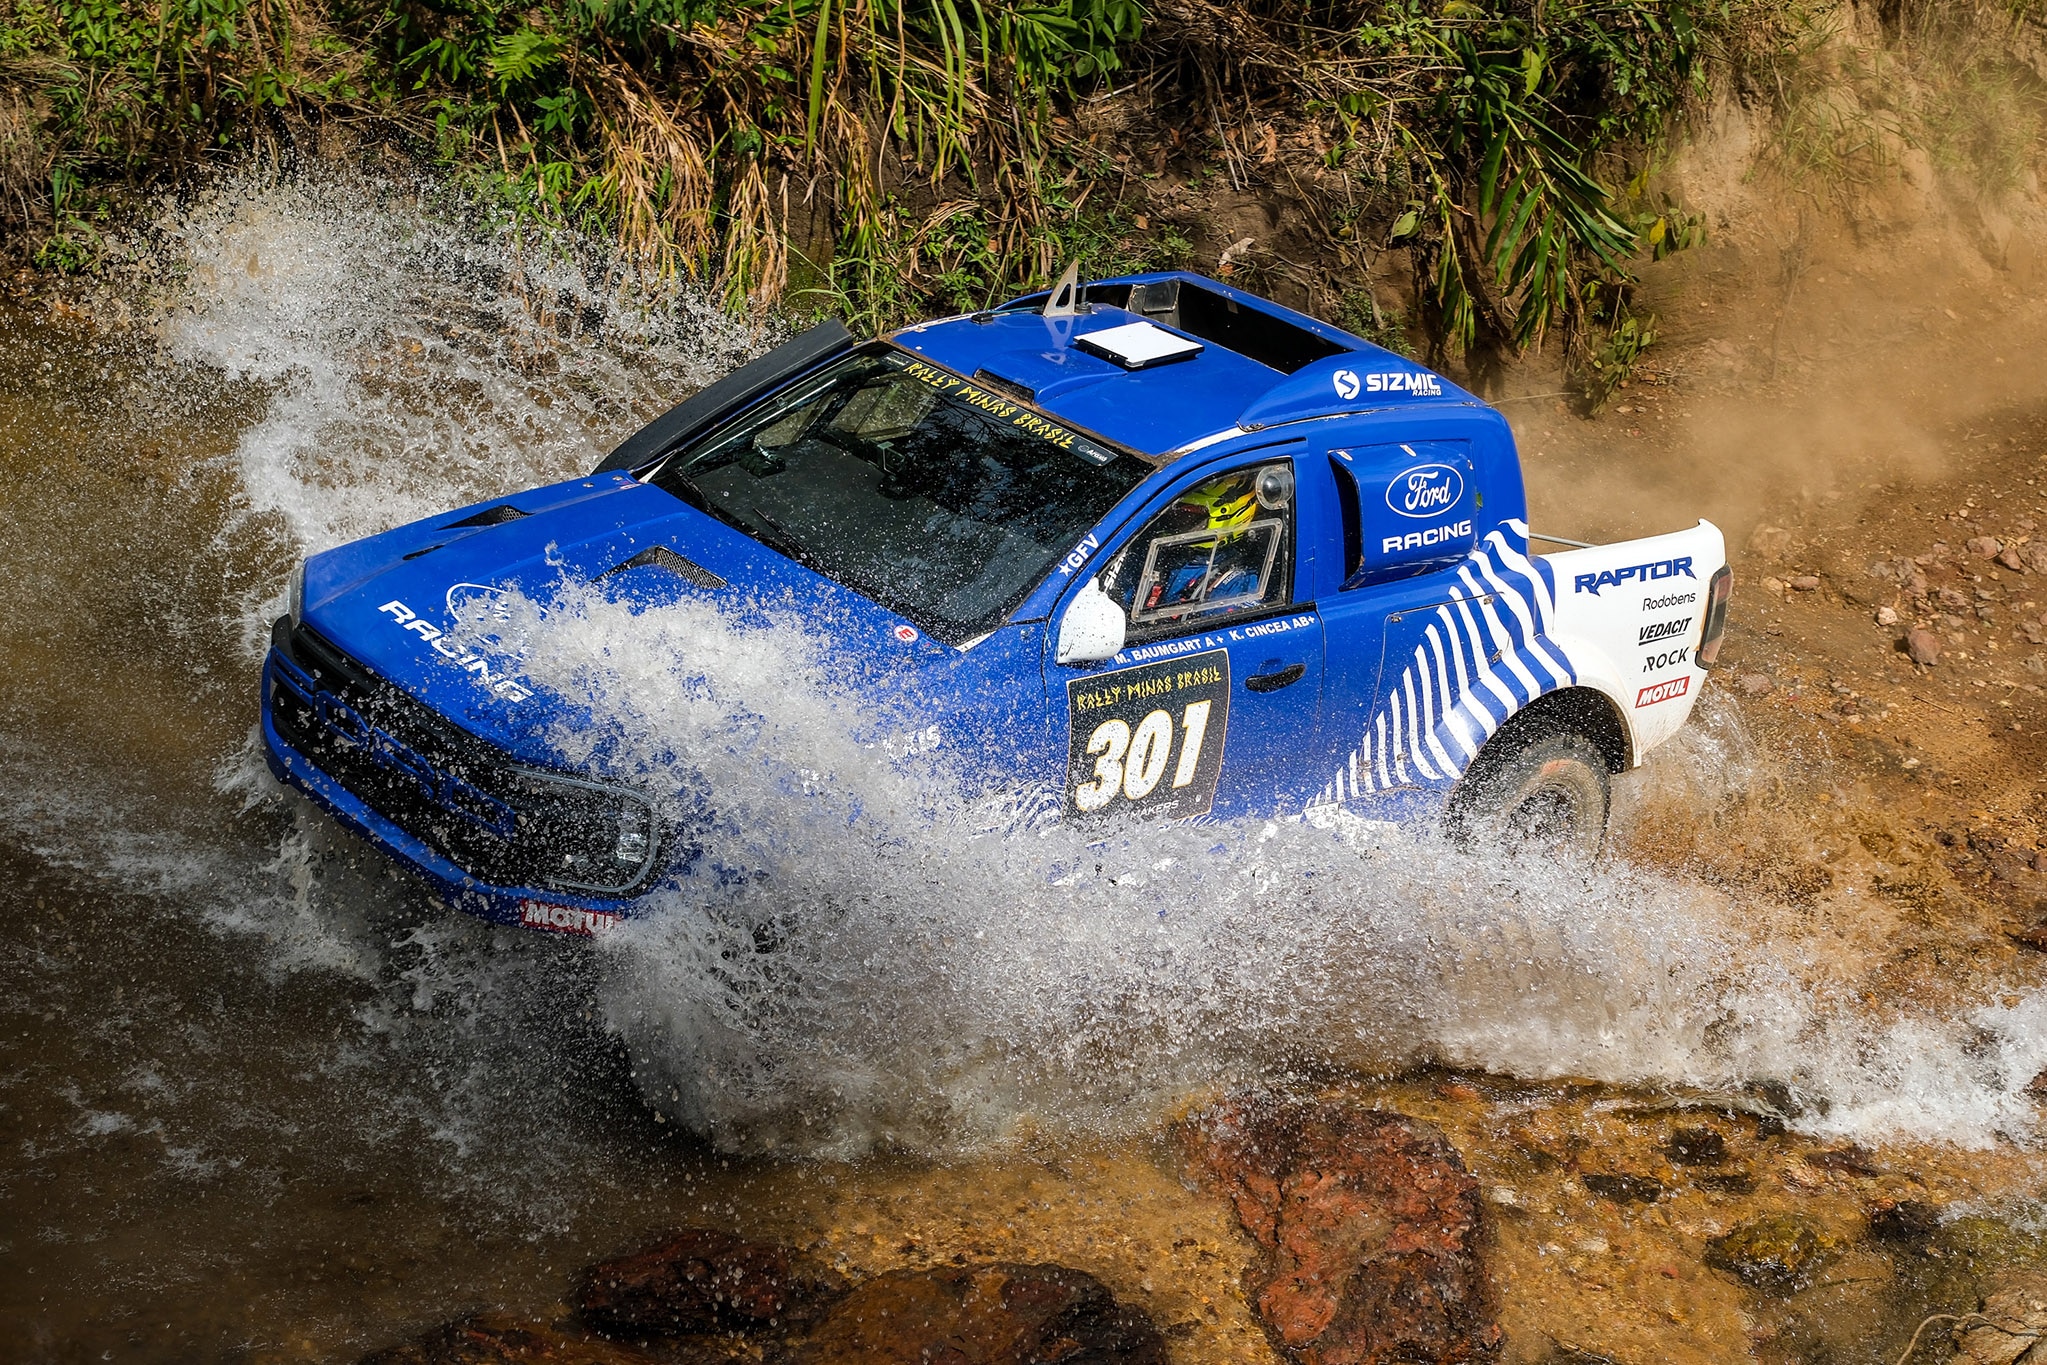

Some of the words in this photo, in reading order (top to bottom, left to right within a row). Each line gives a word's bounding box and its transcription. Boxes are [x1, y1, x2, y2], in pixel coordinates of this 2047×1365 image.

[1366, 372, 1441, 391] SIZMIC
[1412, 388, 1441, 396] RACING
[903, 362, 960, 389] RALLY
[955, 386, 1017, 417] MINAS
[1013, 413, 1076, 449] BRASIL
[1405, 471, 1451, 511] Ford
[1067, 532, 1099, 568] GFV
[1383, 519, 1472, 554] RACING
[1575, 556, 1697, 597] RAPTOR
[1642, 592, 1696, 611] Rodobens
[1114, 653, 1131, 665] M.
[1134, 638, 1202, 662] BAUMGART
[1229, 629, 1245, 641] K.
[1245, 617, 1291, 637] CINCEA
[1293, 614, 1316, 628] AB+
[1638, 617, 1692, 641] VEDACIT
[1643, 647, 1690, 673] ROCK
[1077, 687, 1121, 711] RALLY
[1127, 677, 1172, 700] MINAS
[1177, 666, 1222, 690] BRASIL
[1640, 679, 1687, 706] MOTUL
[1075, 700, 1212, 813] 301
